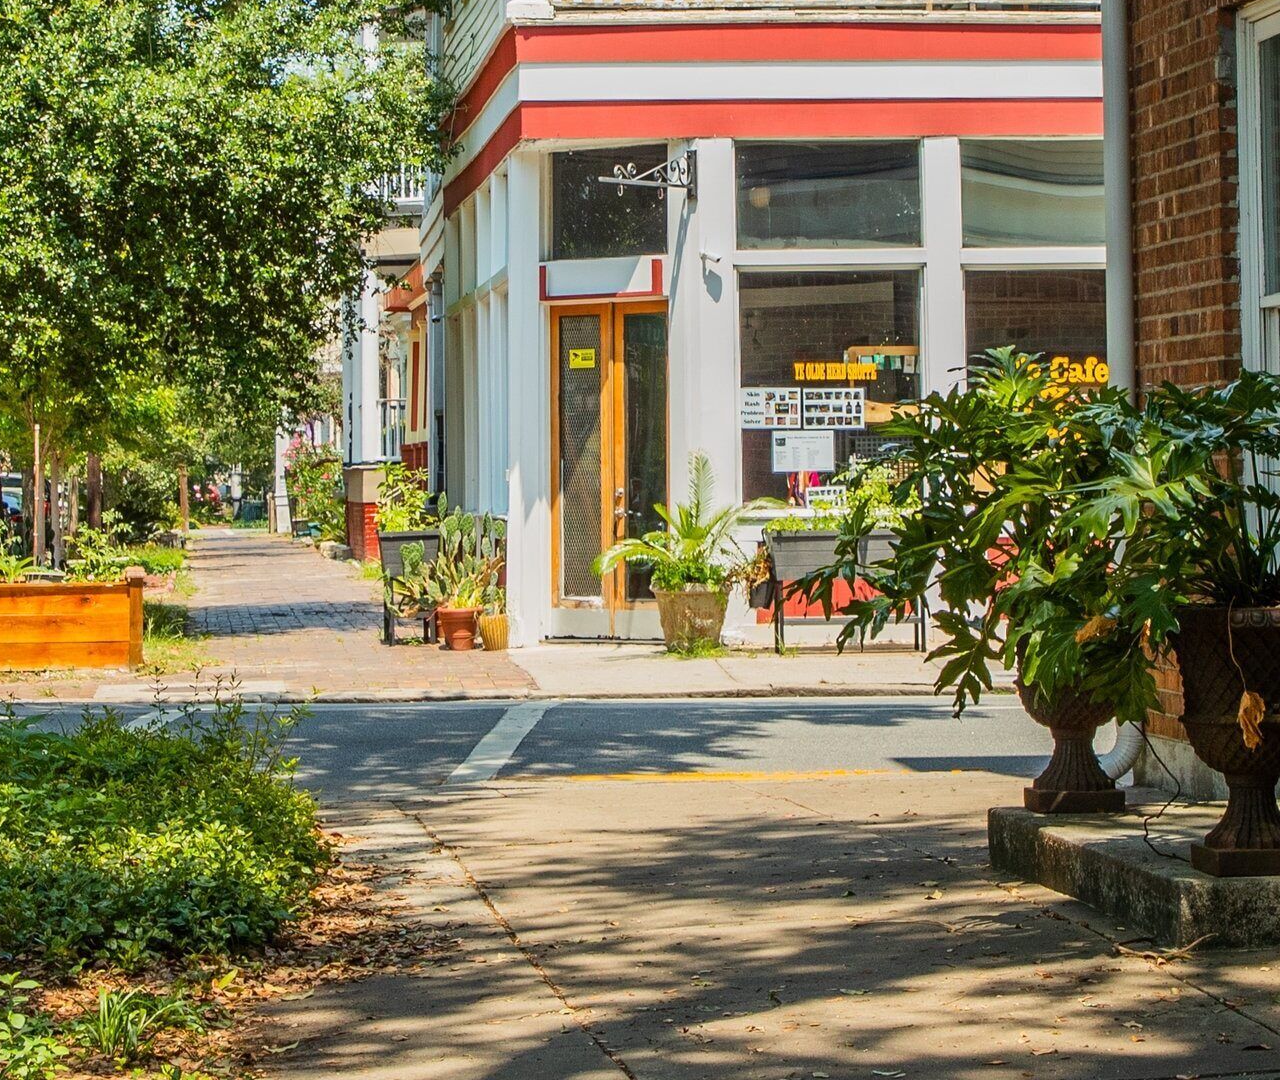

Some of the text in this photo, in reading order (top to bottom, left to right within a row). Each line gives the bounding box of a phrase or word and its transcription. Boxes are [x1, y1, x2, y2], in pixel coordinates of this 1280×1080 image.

[794, 363, 805, 380] YE
[805, 363, 825, 380] OLDE
[847, 363, 877, 380] SHOPPE
[1050, 357, 1109, 383] Cafe
